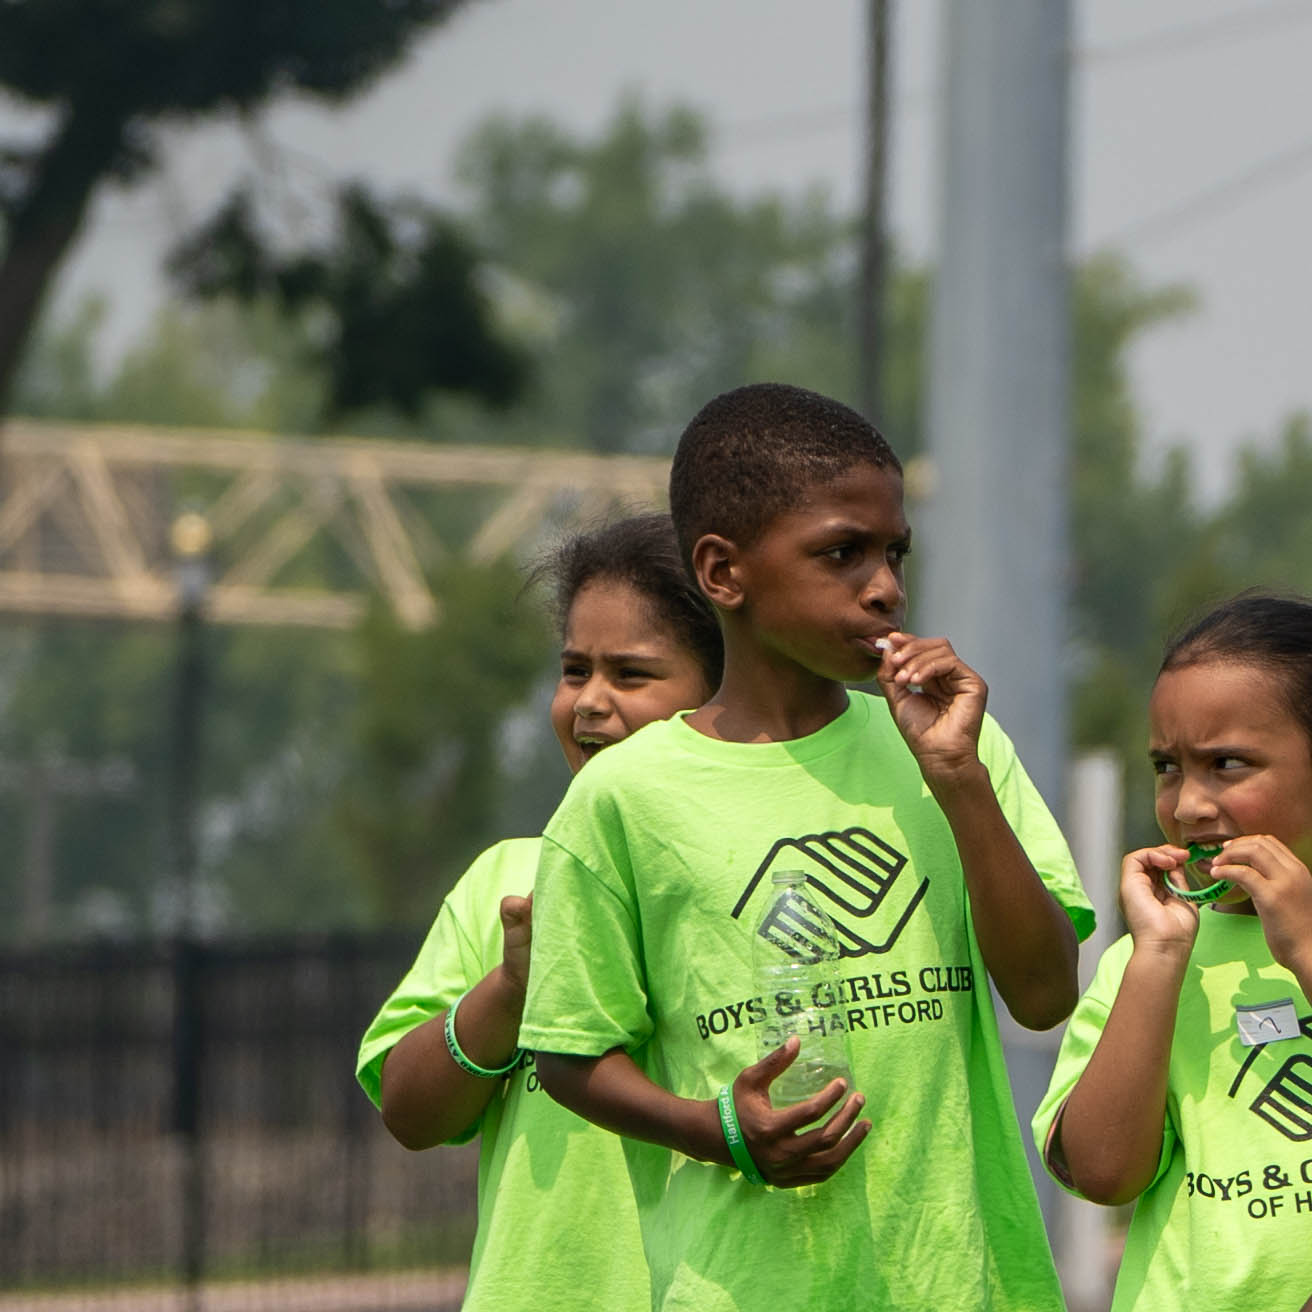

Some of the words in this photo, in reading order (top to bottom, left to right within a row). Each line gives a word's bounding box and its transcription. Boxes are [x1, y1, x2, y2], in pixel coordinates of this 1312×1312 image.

[695, 999, 768, 1041] BOYS
[774, 990, 805, 1018] &
[811, 971, 912, 1009] GIRLS
[808, 998, 944, 1037] HARTFORD
[1263, 1164, 1293, 1190] &
[1247, 1195, 1284, 1219] OF
